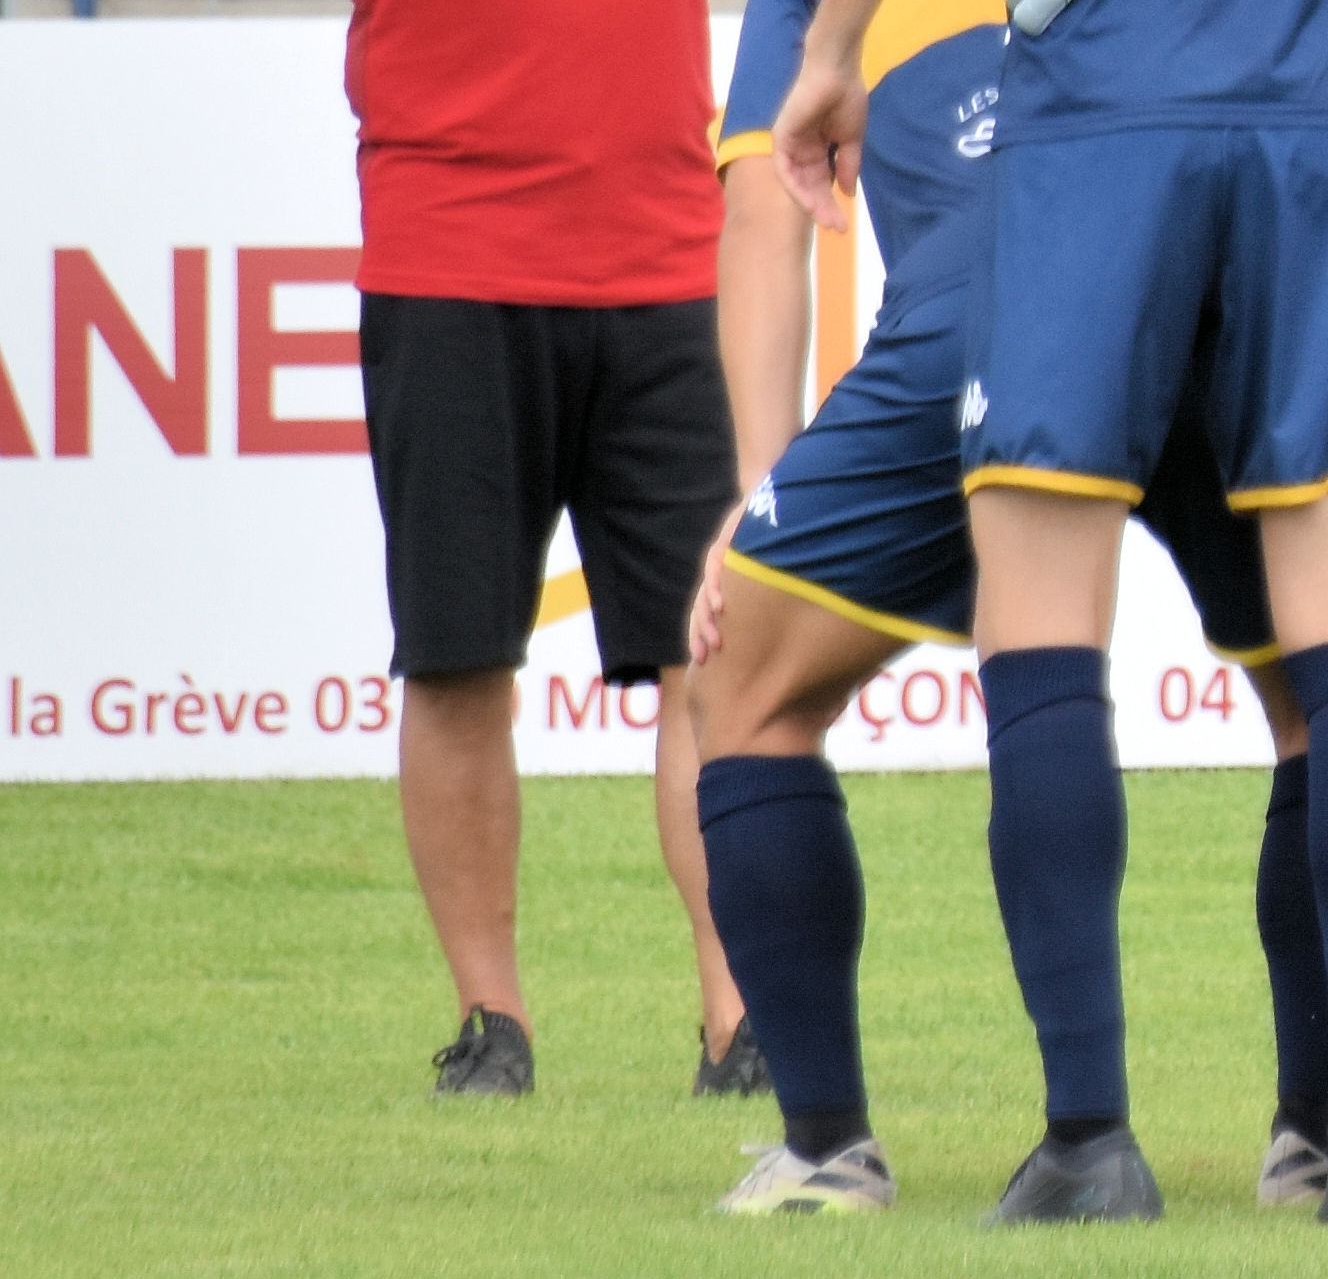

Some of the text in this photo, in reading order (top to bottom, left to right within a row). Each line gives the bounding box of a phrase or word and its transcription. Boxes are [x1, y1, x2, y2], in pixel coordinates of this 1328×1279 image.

[9, 674, 63, 738] la
[90, 672, 290, 738] Grève
[1160, 666, 1236, 722] 04
